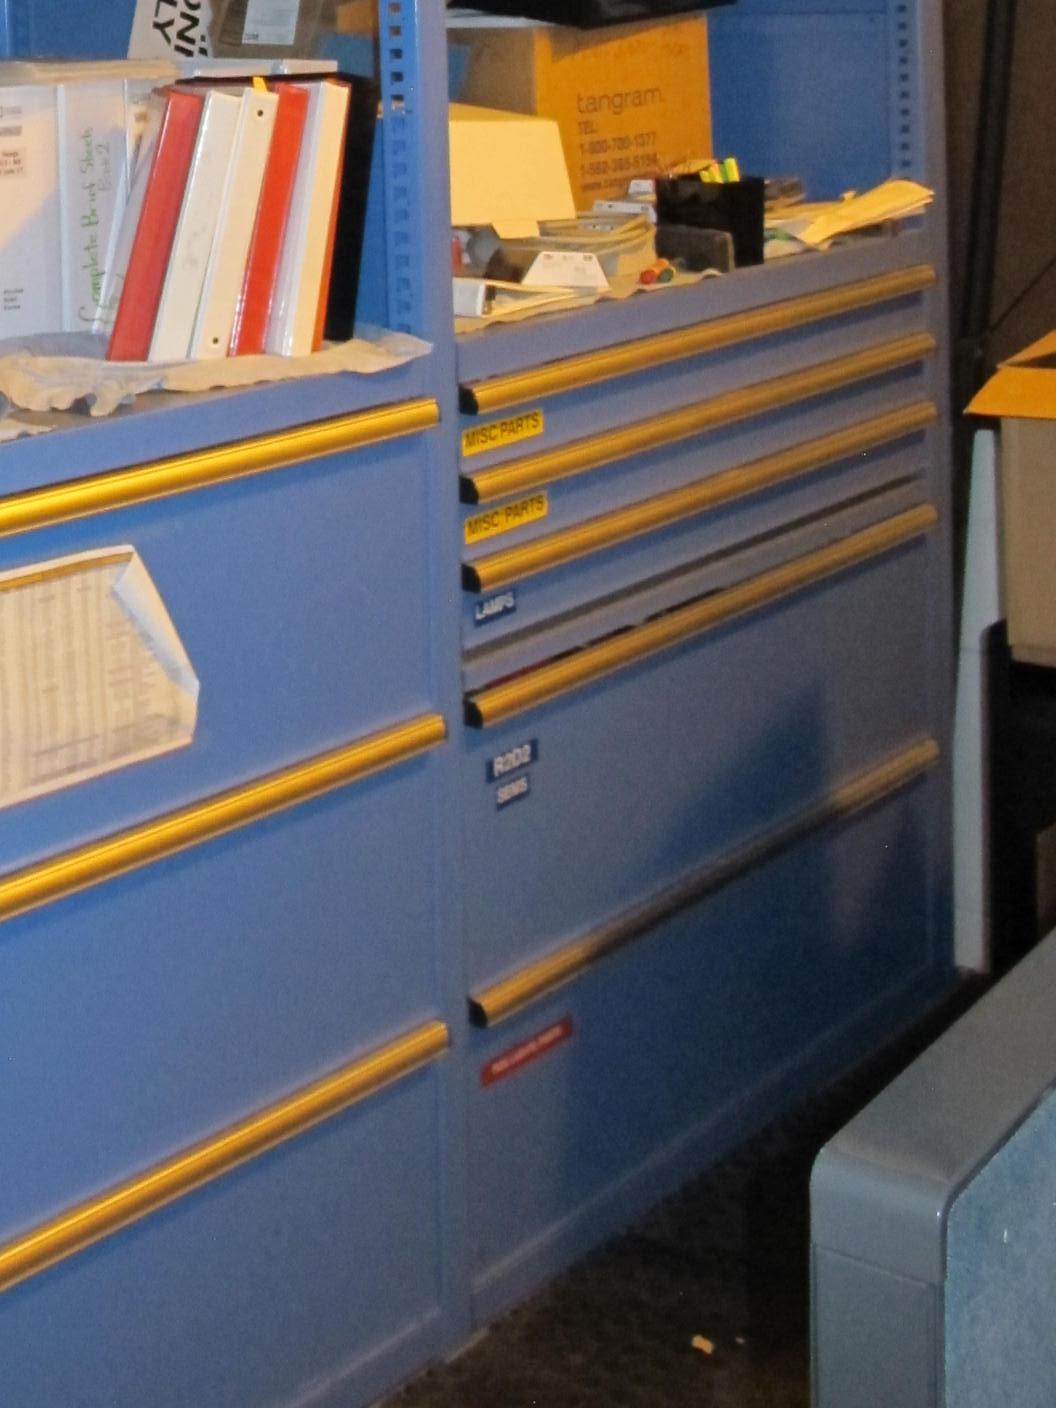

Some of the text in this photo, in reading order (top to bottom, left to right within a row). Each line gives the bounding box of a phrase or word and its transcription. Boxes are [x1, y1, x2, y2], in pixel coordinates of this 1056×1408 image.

[464, 410, 541, 448] MISC PARTS
[467, 494, 544, 537] MISC PARTS
